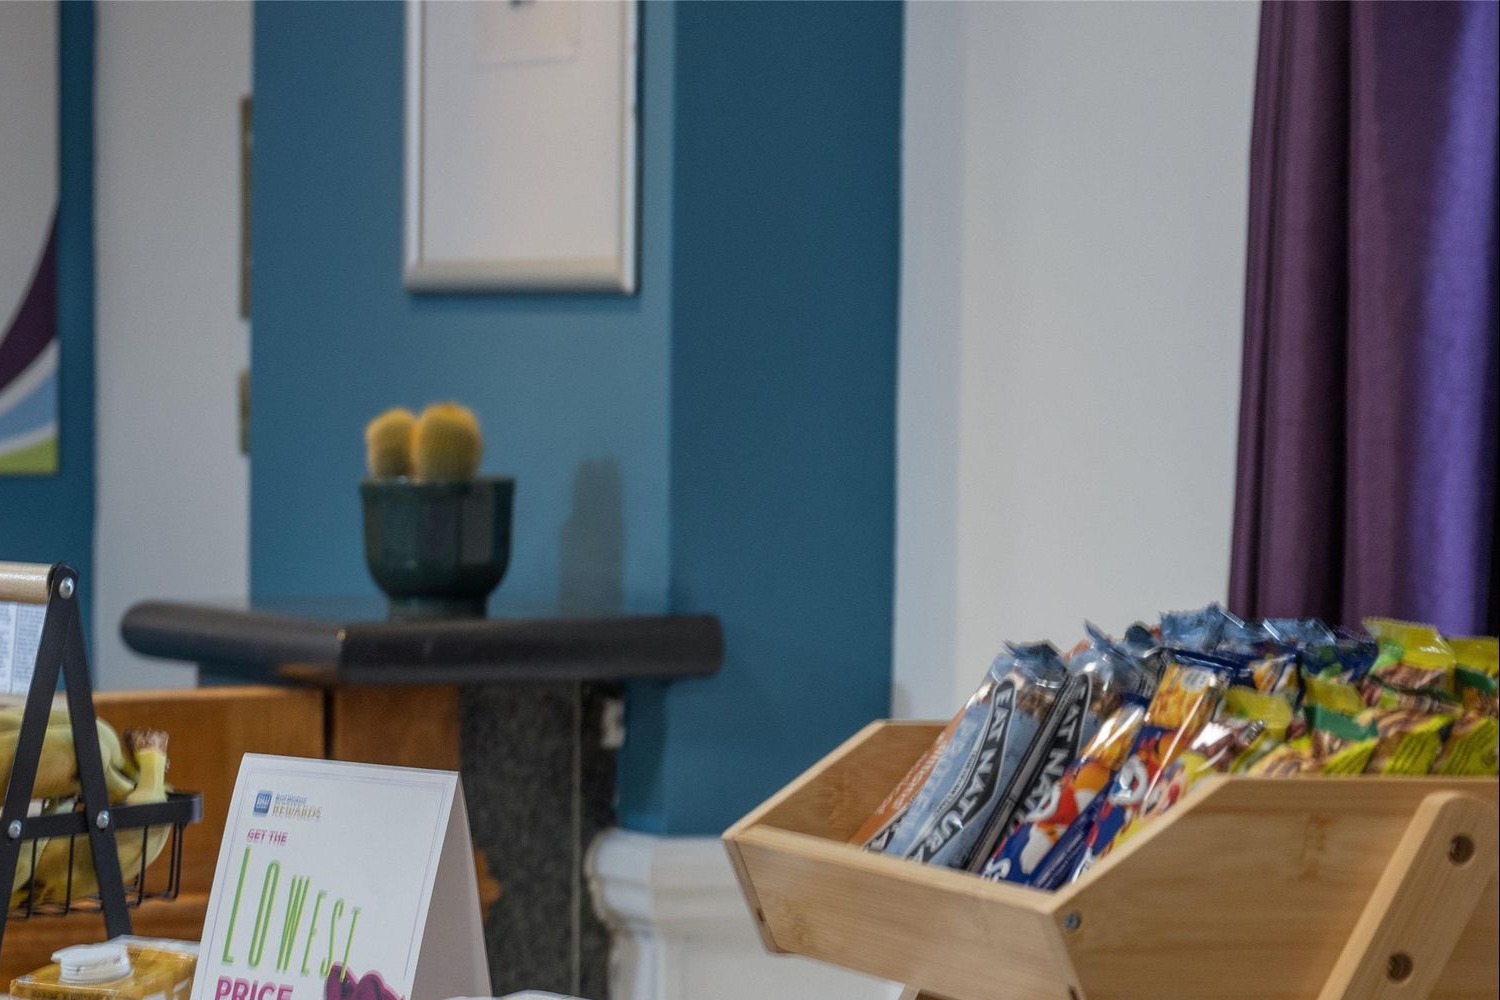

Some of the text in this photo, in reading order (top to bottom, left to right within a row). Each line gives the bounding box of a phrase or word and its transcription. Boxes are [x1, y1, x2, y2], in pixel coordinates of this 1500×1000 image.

[247, 828, 289, 846] GET THE
[906, 748, 998, 863] NATURA
[222, 846, 362, 984] LOWEST
